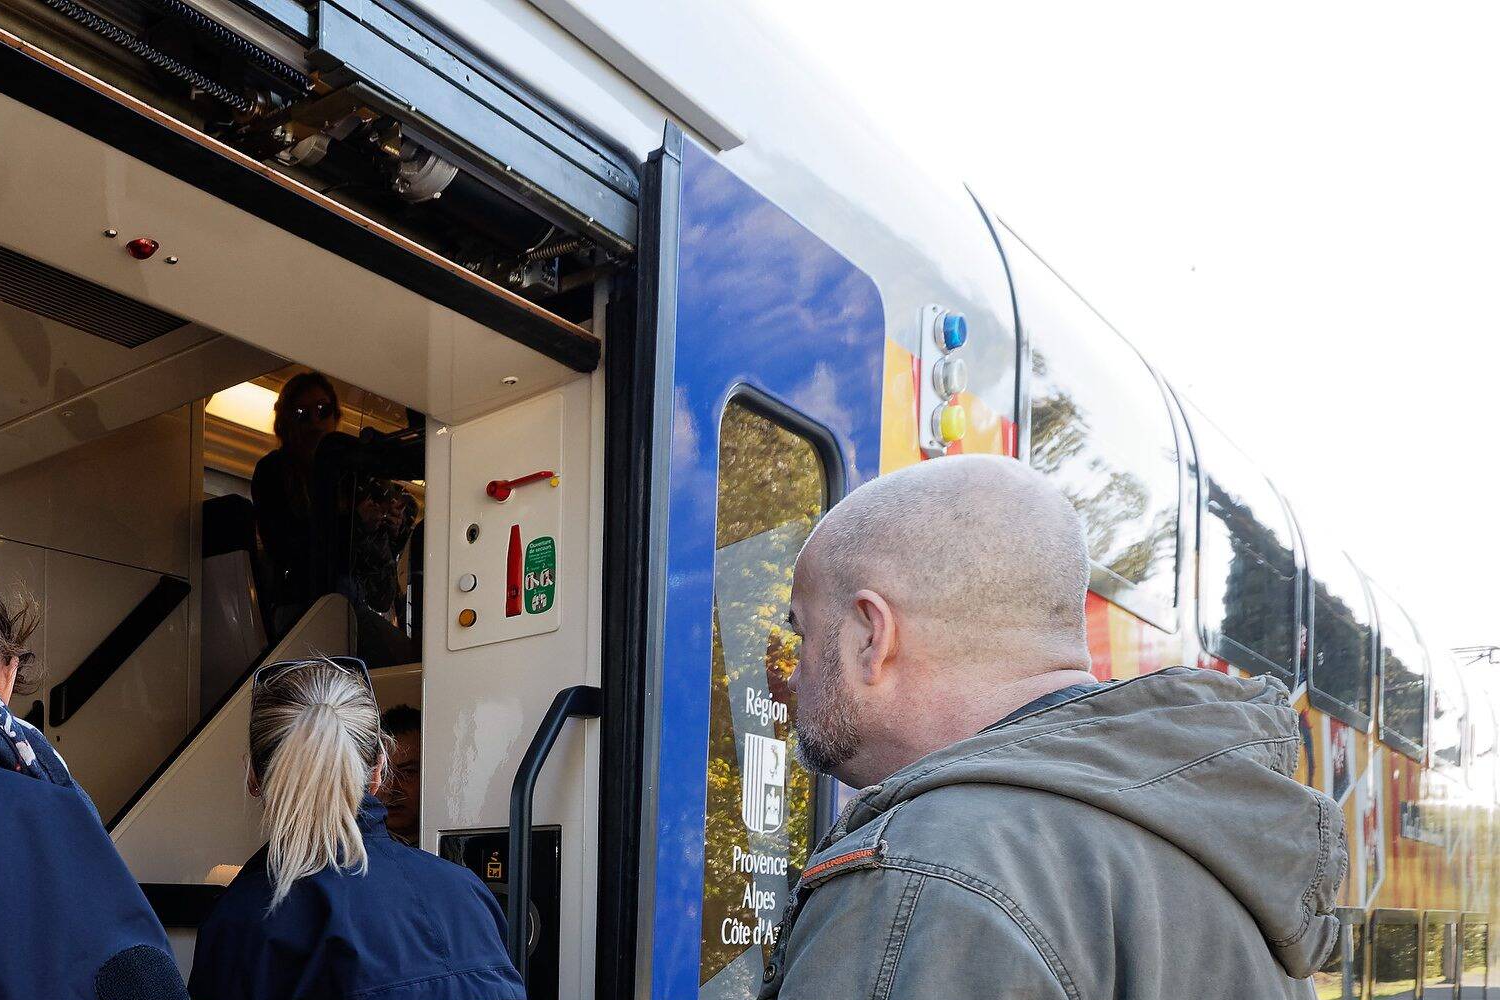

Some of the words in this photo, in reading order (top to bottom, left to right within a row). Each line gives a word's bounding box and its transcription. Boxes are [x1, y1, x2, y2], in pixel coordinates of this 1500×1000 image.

[746, 686, 788, 727] Région
[732, 845, 788, 876] Provence
[741, 881, 776, 918] Alpes
[721, 917, 751, 945] Côte
